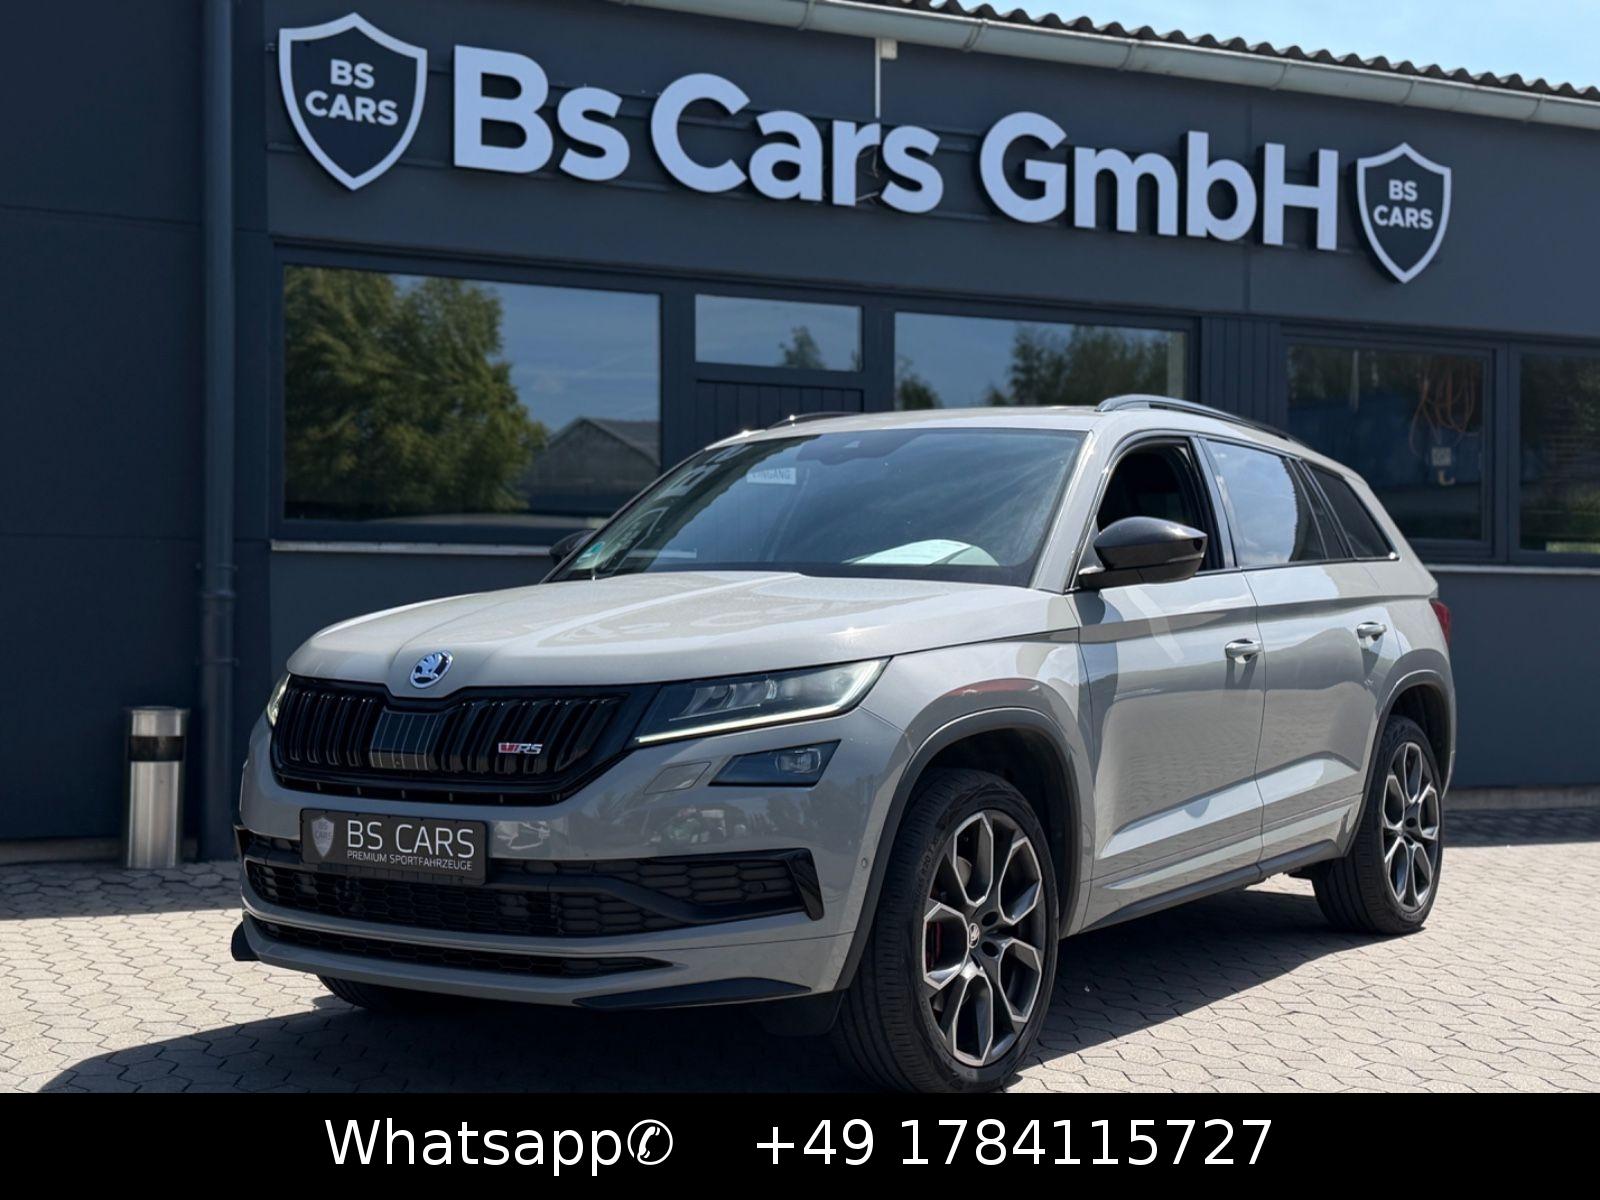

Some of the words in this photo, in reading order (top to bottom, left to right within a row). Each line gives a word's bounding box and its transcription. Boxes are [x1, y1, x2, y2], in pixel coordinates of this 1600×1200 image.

[330, 58, 375, 90] BS
[304, 90, 399, 127] CARS
[454, 44, 631, 182] Bs
[651, 72, 944, 214] Cars
[979, 111, 1339, 251] GmbH
[1388, 178, 1418, 202] BS
[1372, 203, 1434, 231] CARS
[347, 819, 383, 850] BS
[395, 823, 475, 859] CARS
[347, 849, 388, 864] PREMIUM
[389, 854, 473, 872] SPORTFAHRZEUGE
